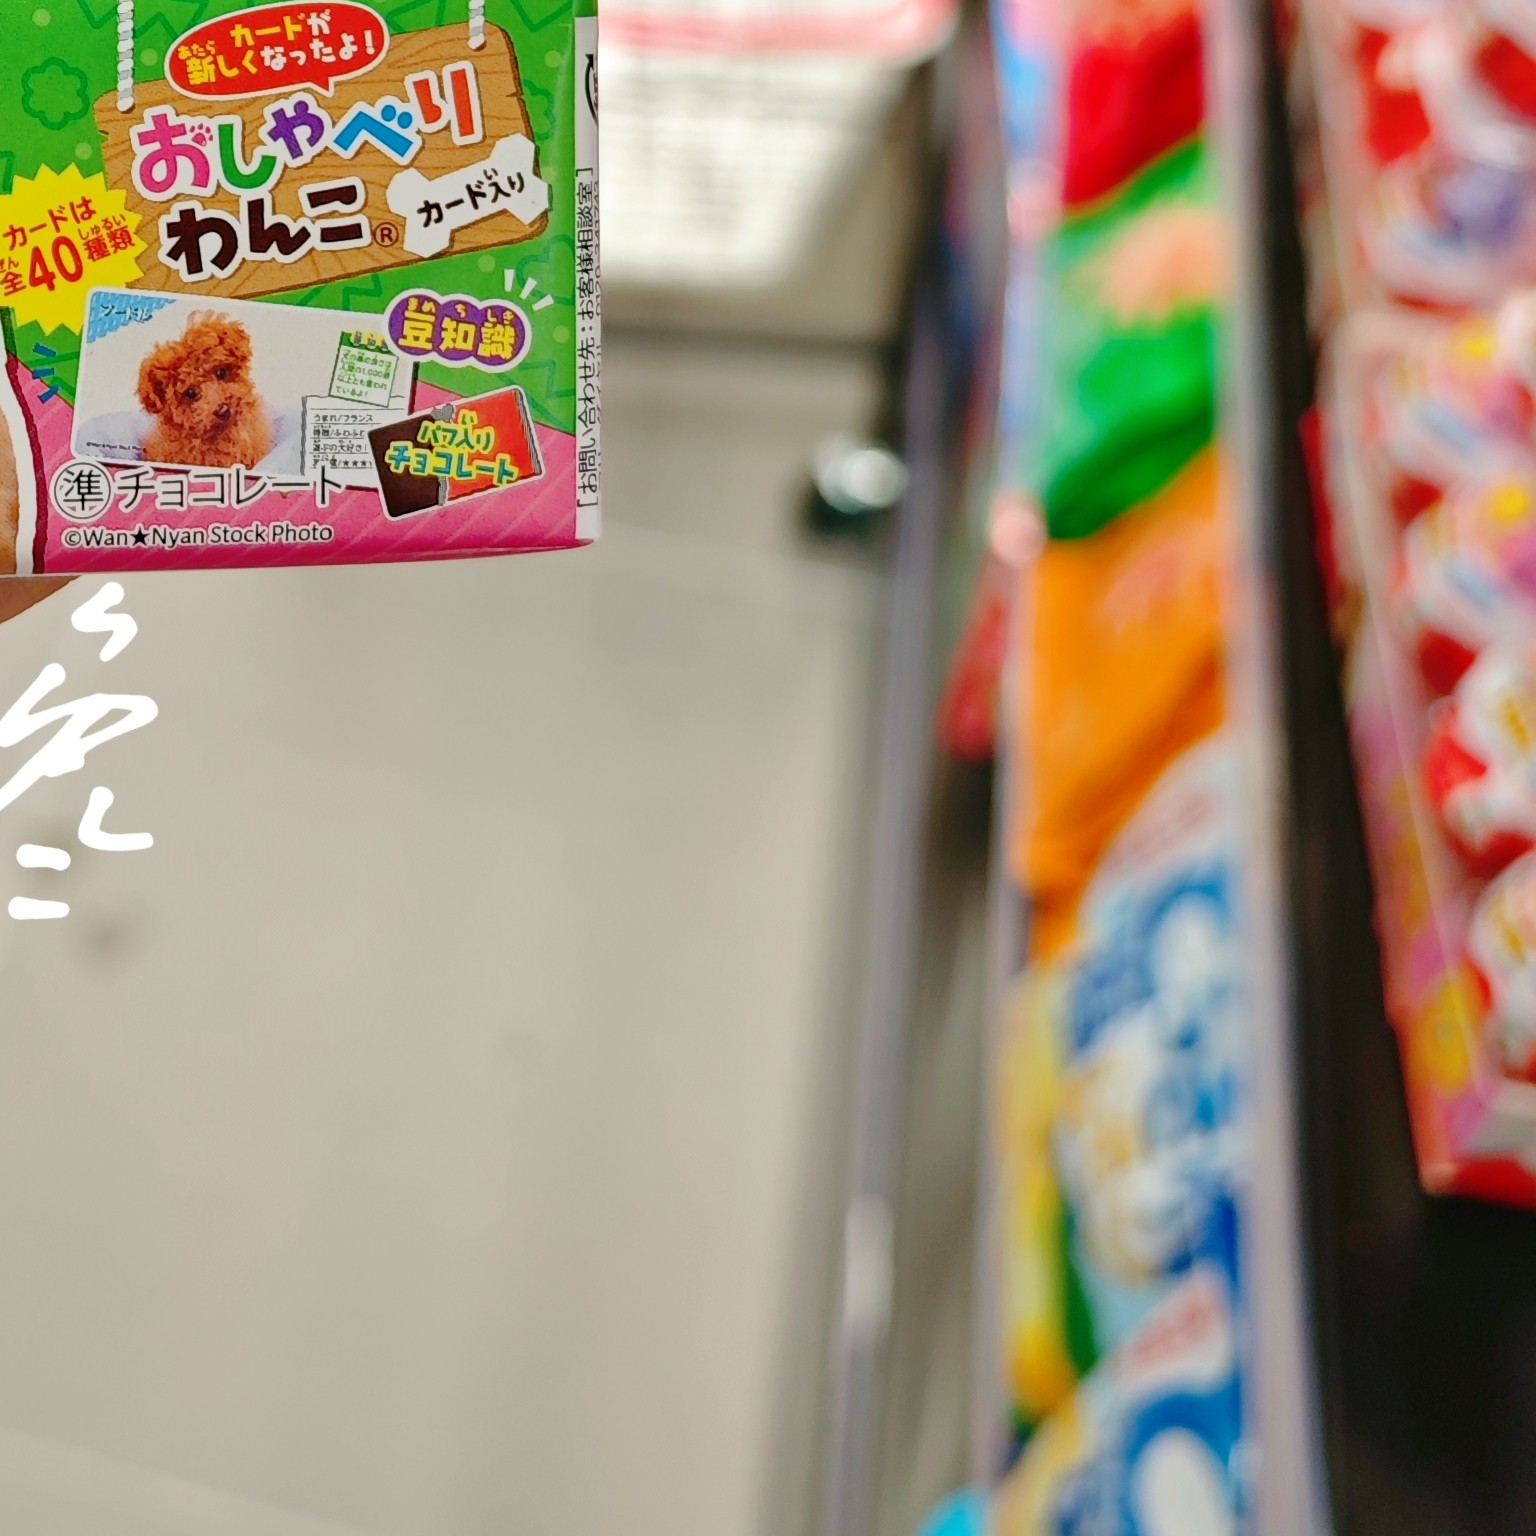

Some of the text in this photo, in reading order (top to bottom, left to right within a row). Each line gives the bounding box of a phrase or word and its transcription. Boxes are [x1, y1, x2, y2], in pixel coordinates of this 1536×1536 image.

[177, 40, 216, 60] あたら
[230, 8, 331, 48] カードが
[138, 68, 474, 193] おしゃべり
[2, 196, 96, 251] カードは
[417, 172, 525, 227] カード入り
[0, 225, 135, 296] 全40種類
[398, 310, 515, 359] 豆知識
[388, 445, 515, 485] チョコレート
[211, 524, 266, 543] Stock
[272, 524, 333, 542] Photo
